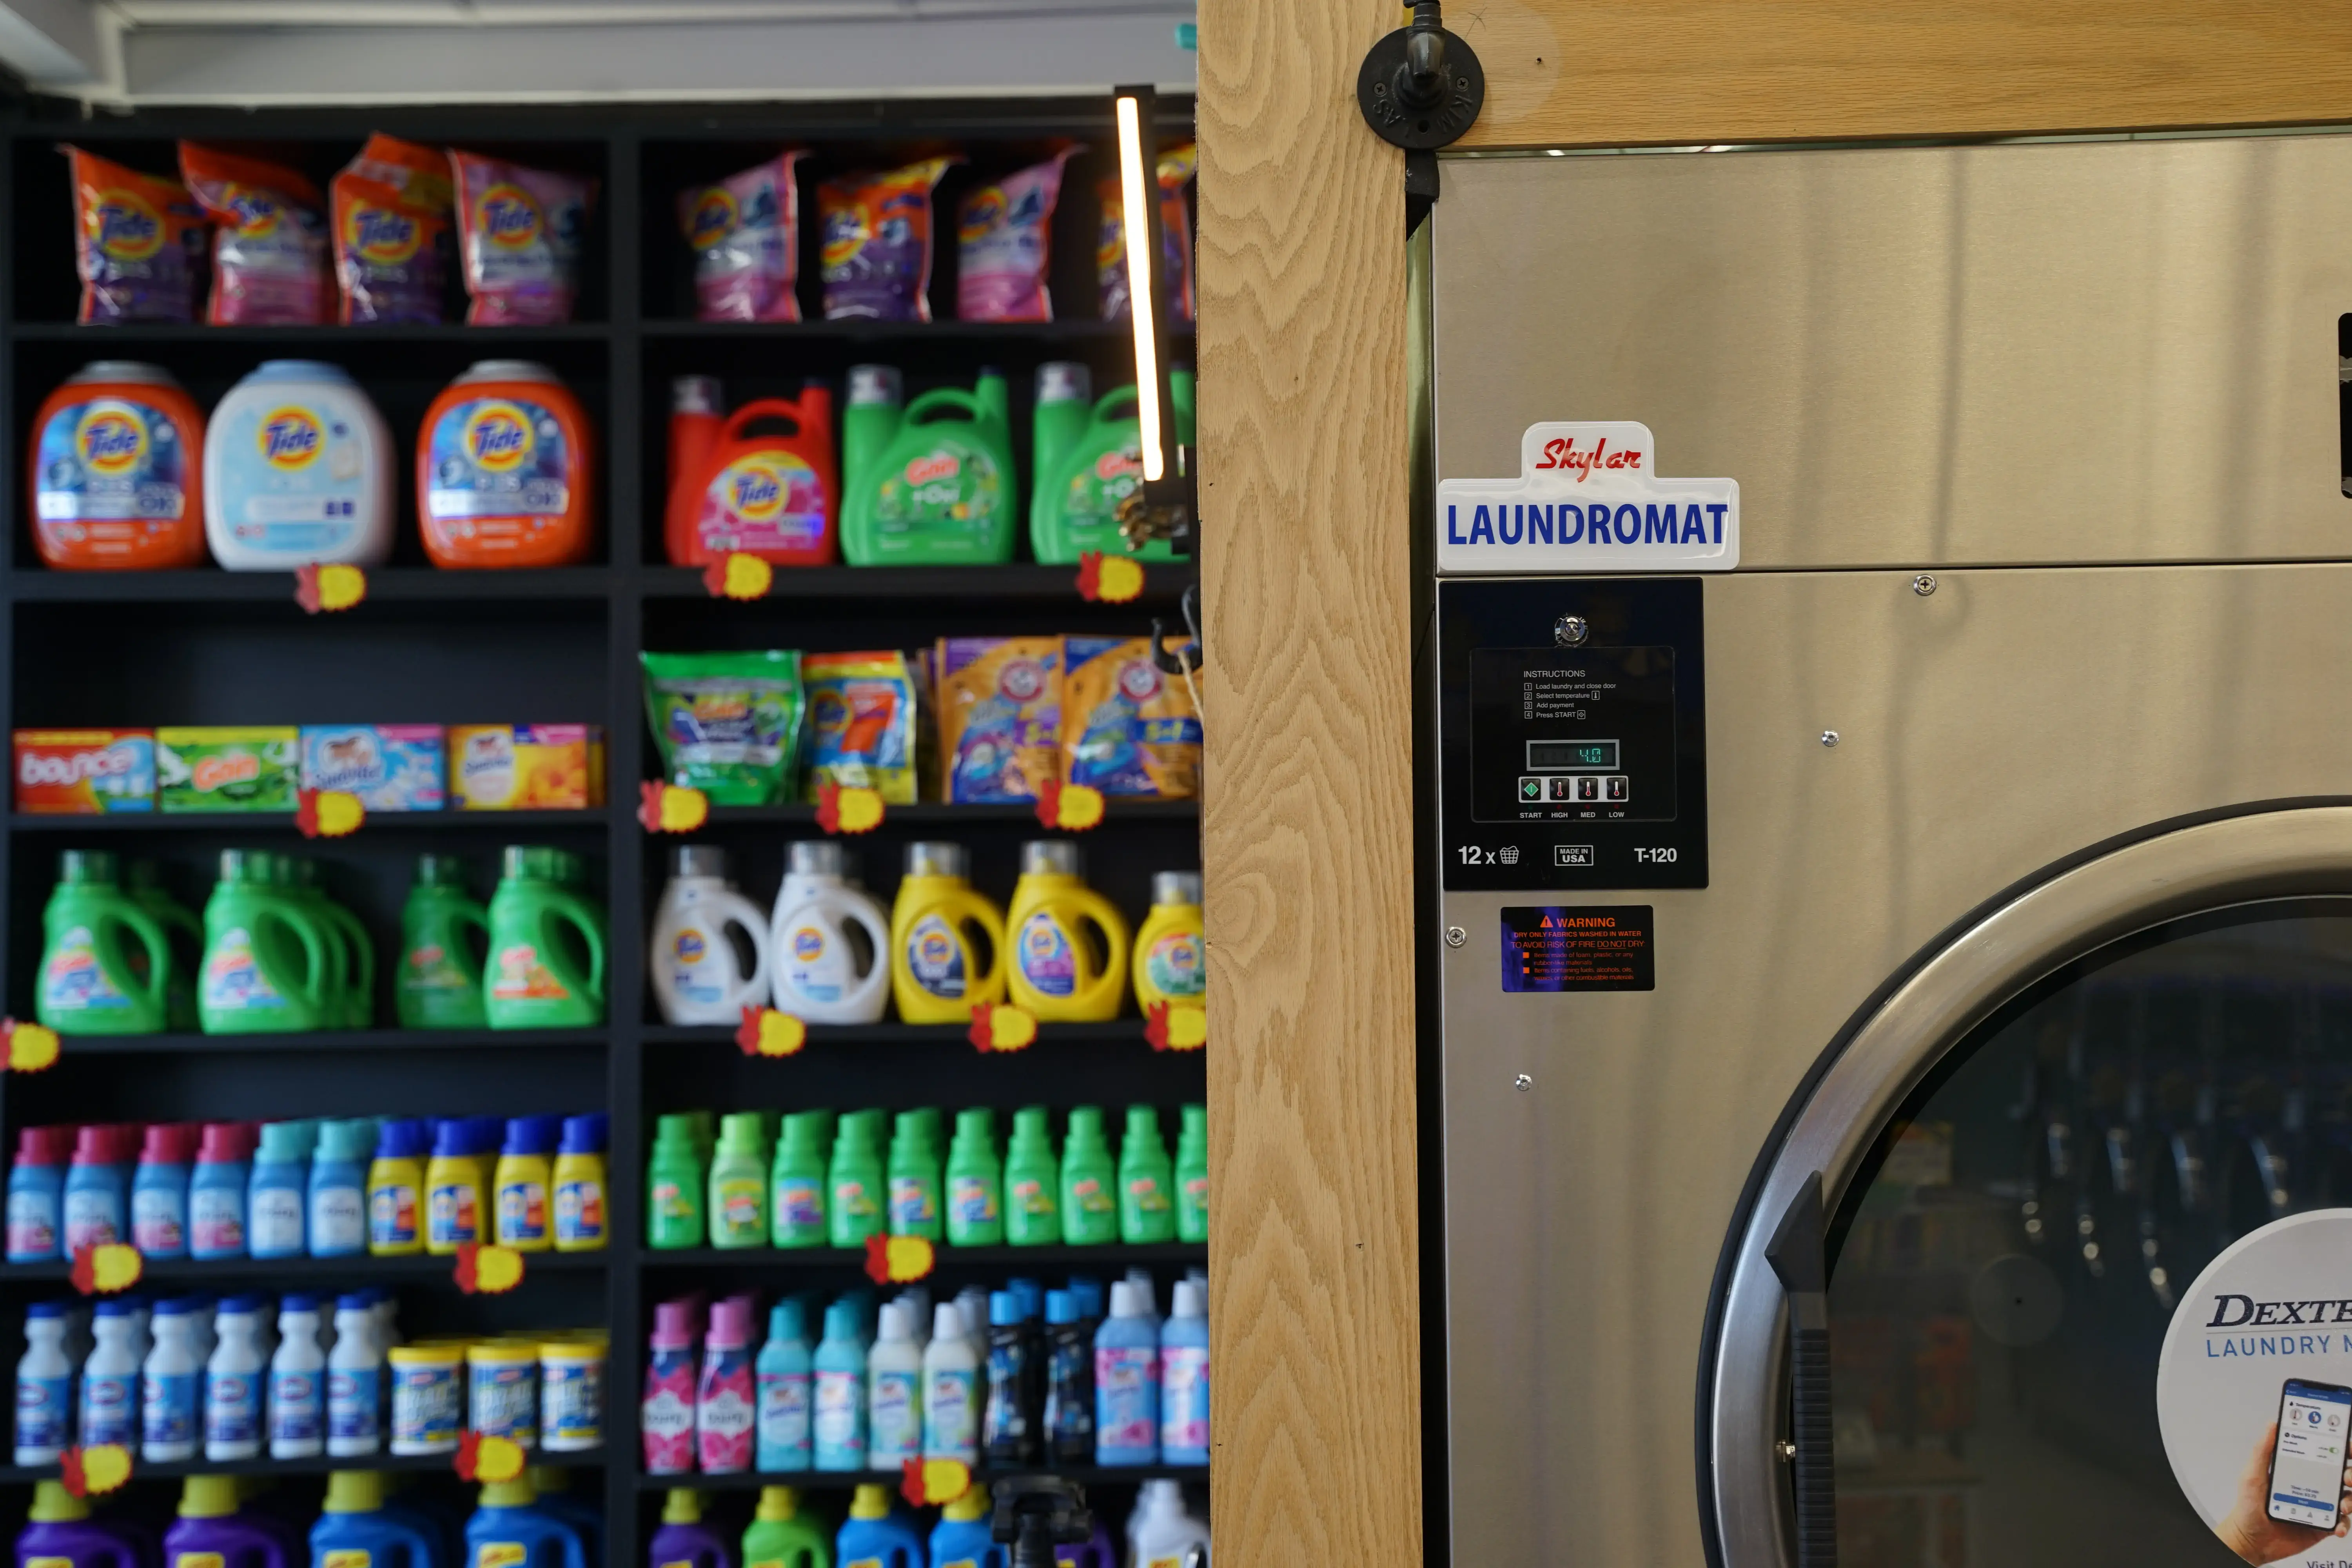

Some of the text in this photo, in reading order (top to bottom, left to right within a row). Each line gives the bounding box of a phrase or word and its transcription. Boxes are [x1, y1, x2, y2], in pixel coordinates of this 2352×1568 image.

[85, 426, 138, 457] Tide
[266, 423, 318, 455] Tide
[475, 423, 524, 454] Tide
[1535, 438, 1641, 483] Skylar
[737, 477, 779, 508] Tide
[1448, 504, 1728, 544] LAUNDROMAT
[1580, 748, 1601, 763] 4.0
[195, 755, 259, 791] Gain
[1459, 846, 1481, 864] 12
[1562, 855, 1586, 863] USA
[1634, 848, 1677, 862] T-120
[1556, 918, 1615, 927] WARNING
[2207, 1335, 2330, 1357] LAUNDRY
